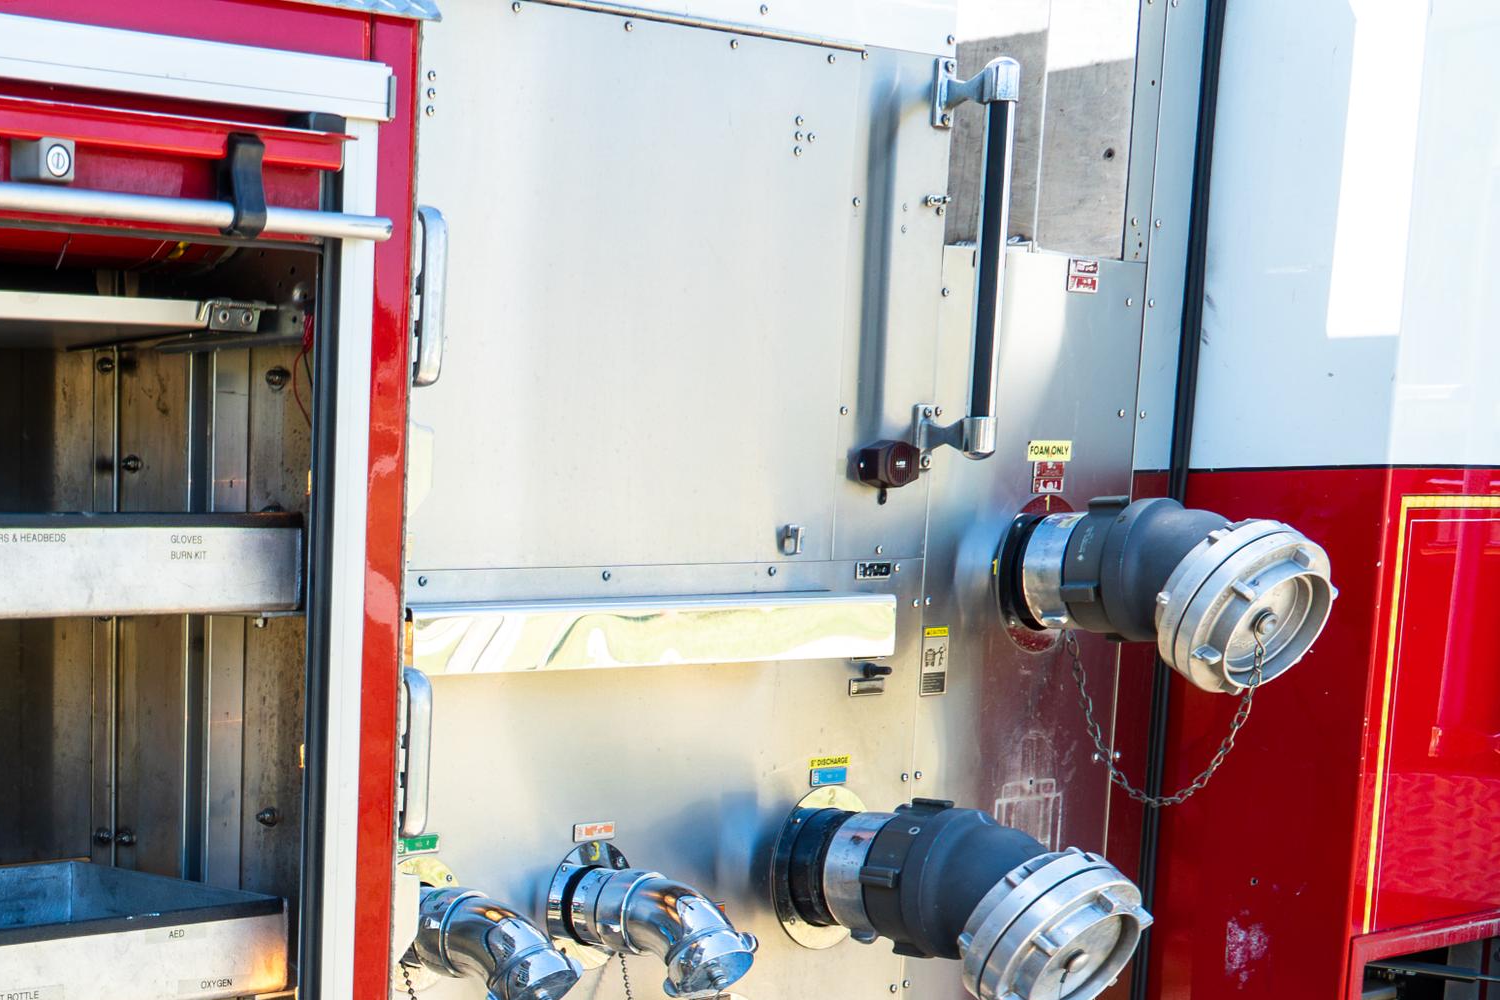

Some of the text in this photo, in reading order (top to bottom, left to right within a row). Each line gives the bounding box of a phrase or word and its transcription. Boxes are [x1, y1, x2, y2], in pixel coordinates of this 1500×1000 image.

[1029, 446, 1069, 455] FOAM ONLY
[1044, 495, 1051, 512] 1
[12, 533, 18, 543] &
[20, 533, 67, 543] HEADBEDS
[170, 534, 203, 544] GLOVES
[170, 550, 207, 560] BURN KIT
[817, 756, 849, 767] DISCHARGE
[827, 788, 836, 806] 2
[168, 929, 185, 939] AED
[200, 978, 233, 990] OXYGEN
